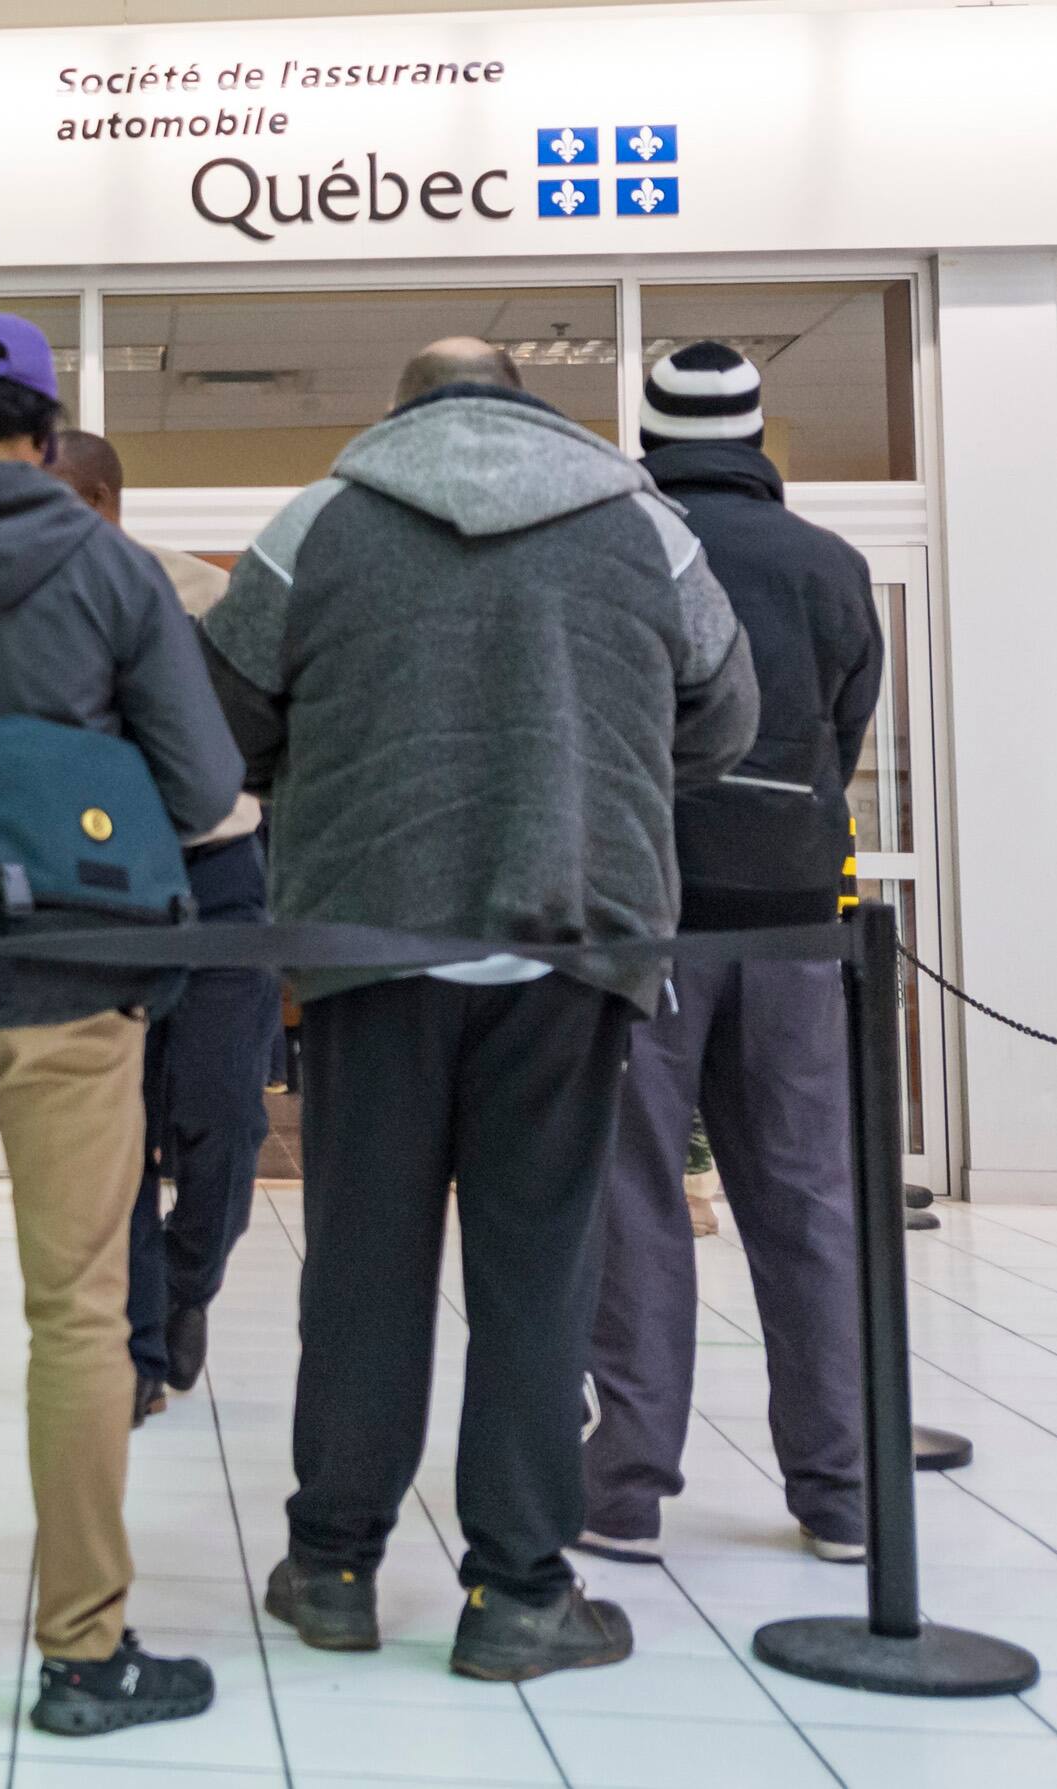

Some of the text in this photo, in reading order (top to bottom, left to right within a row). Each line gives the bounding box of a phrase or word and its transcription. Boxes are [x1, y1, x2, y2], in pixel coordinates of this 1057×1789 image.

[57, 59, 505, 95] Société de l'assurance
[56, 106, 289, 141] automobile
[190, 151, 515, 243] Québec
